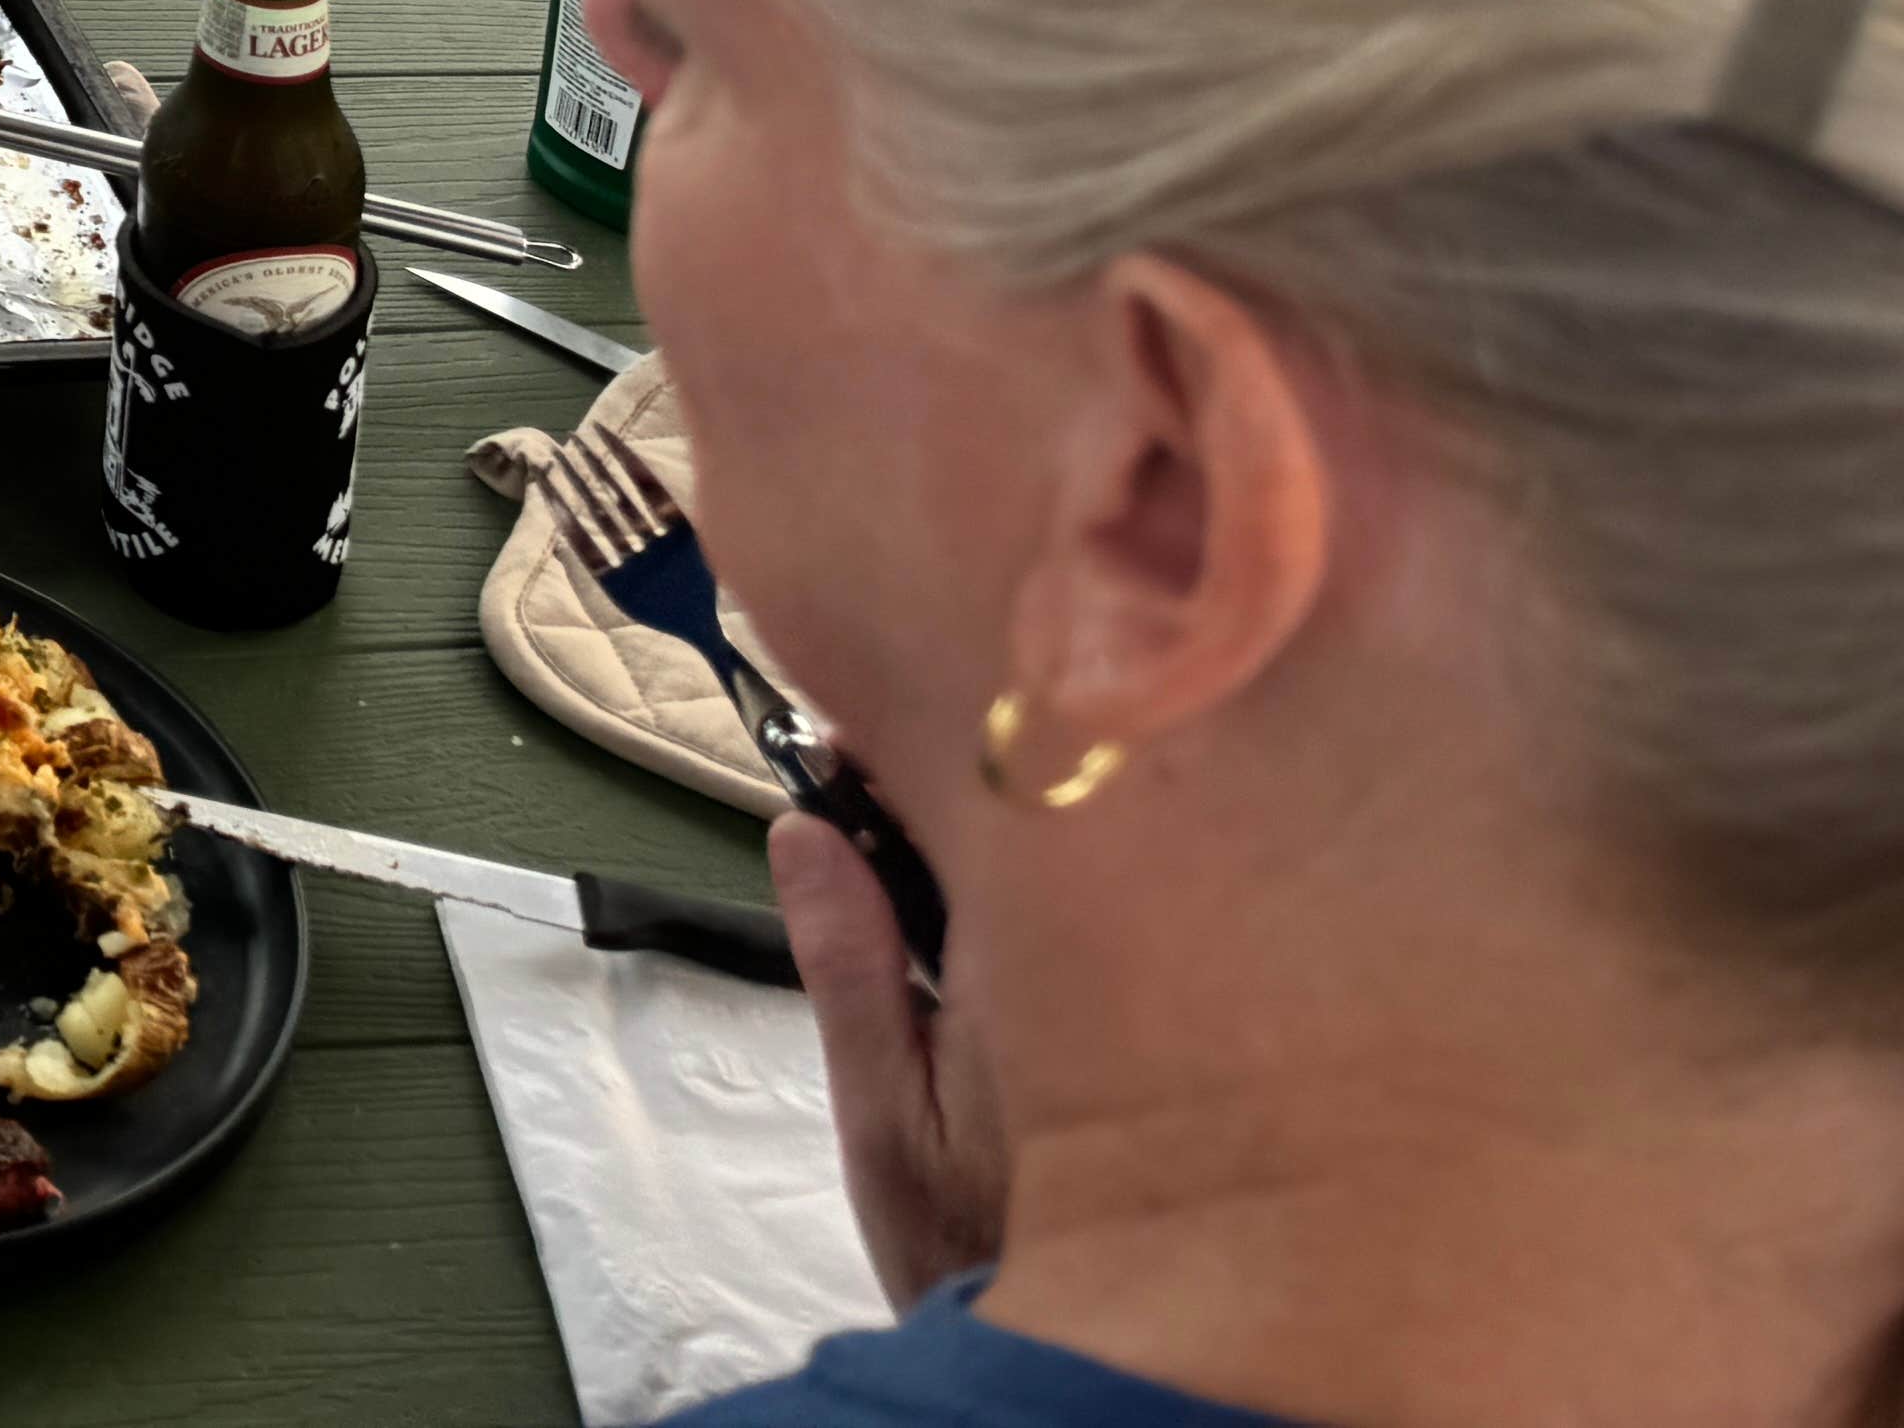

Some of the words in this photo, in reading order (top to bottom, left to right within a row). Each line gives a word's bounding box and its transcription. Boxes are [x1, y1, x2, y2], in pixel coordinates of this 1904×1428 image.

[193, 272, 254, 308] MERICA'S
[263, 265, 324, 278] OLDEST
[115, 282, 191, 401] IDGE
